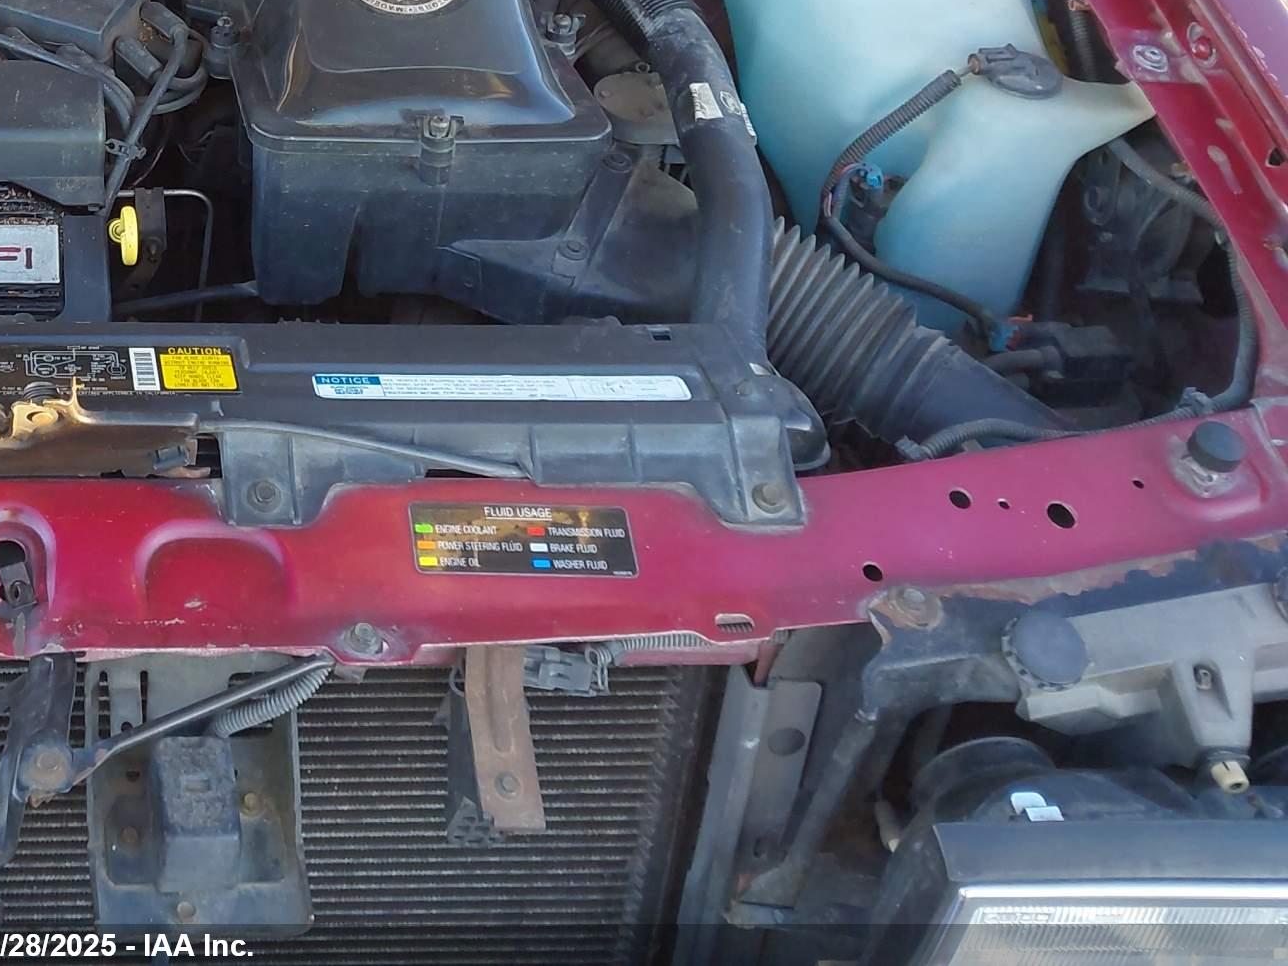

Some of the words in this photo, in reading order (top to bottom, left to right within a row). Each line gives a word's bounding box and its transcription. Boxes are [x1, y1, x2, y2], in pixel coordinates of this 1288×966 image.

[168, 347, 221, 355] CAUTION
[484, 506, 514, 518] FLUID
[517, 508, 552, 518] USAGE
[436, 524, 463, 534] ENGINE
[463, 525, 497, 535] COOLANT
[548, 527, 603, 538] TRANSMISSION
[604, 528, 625, 538] FLUID
[437, 541, 464, 550] POWER
[465, 541, 501, 552] STEERING
[502, 542, 523, 552] FLUID
[550, 543, 576, 553] BRAKE
[577, 544, 598, 553] FLUID
[440, 557, 467, 567] ENGINE
[469, 557, 480, 567] OIL
[553, 559, 585, 570] WASHER
[587, 560, 608, 570] FLUID
